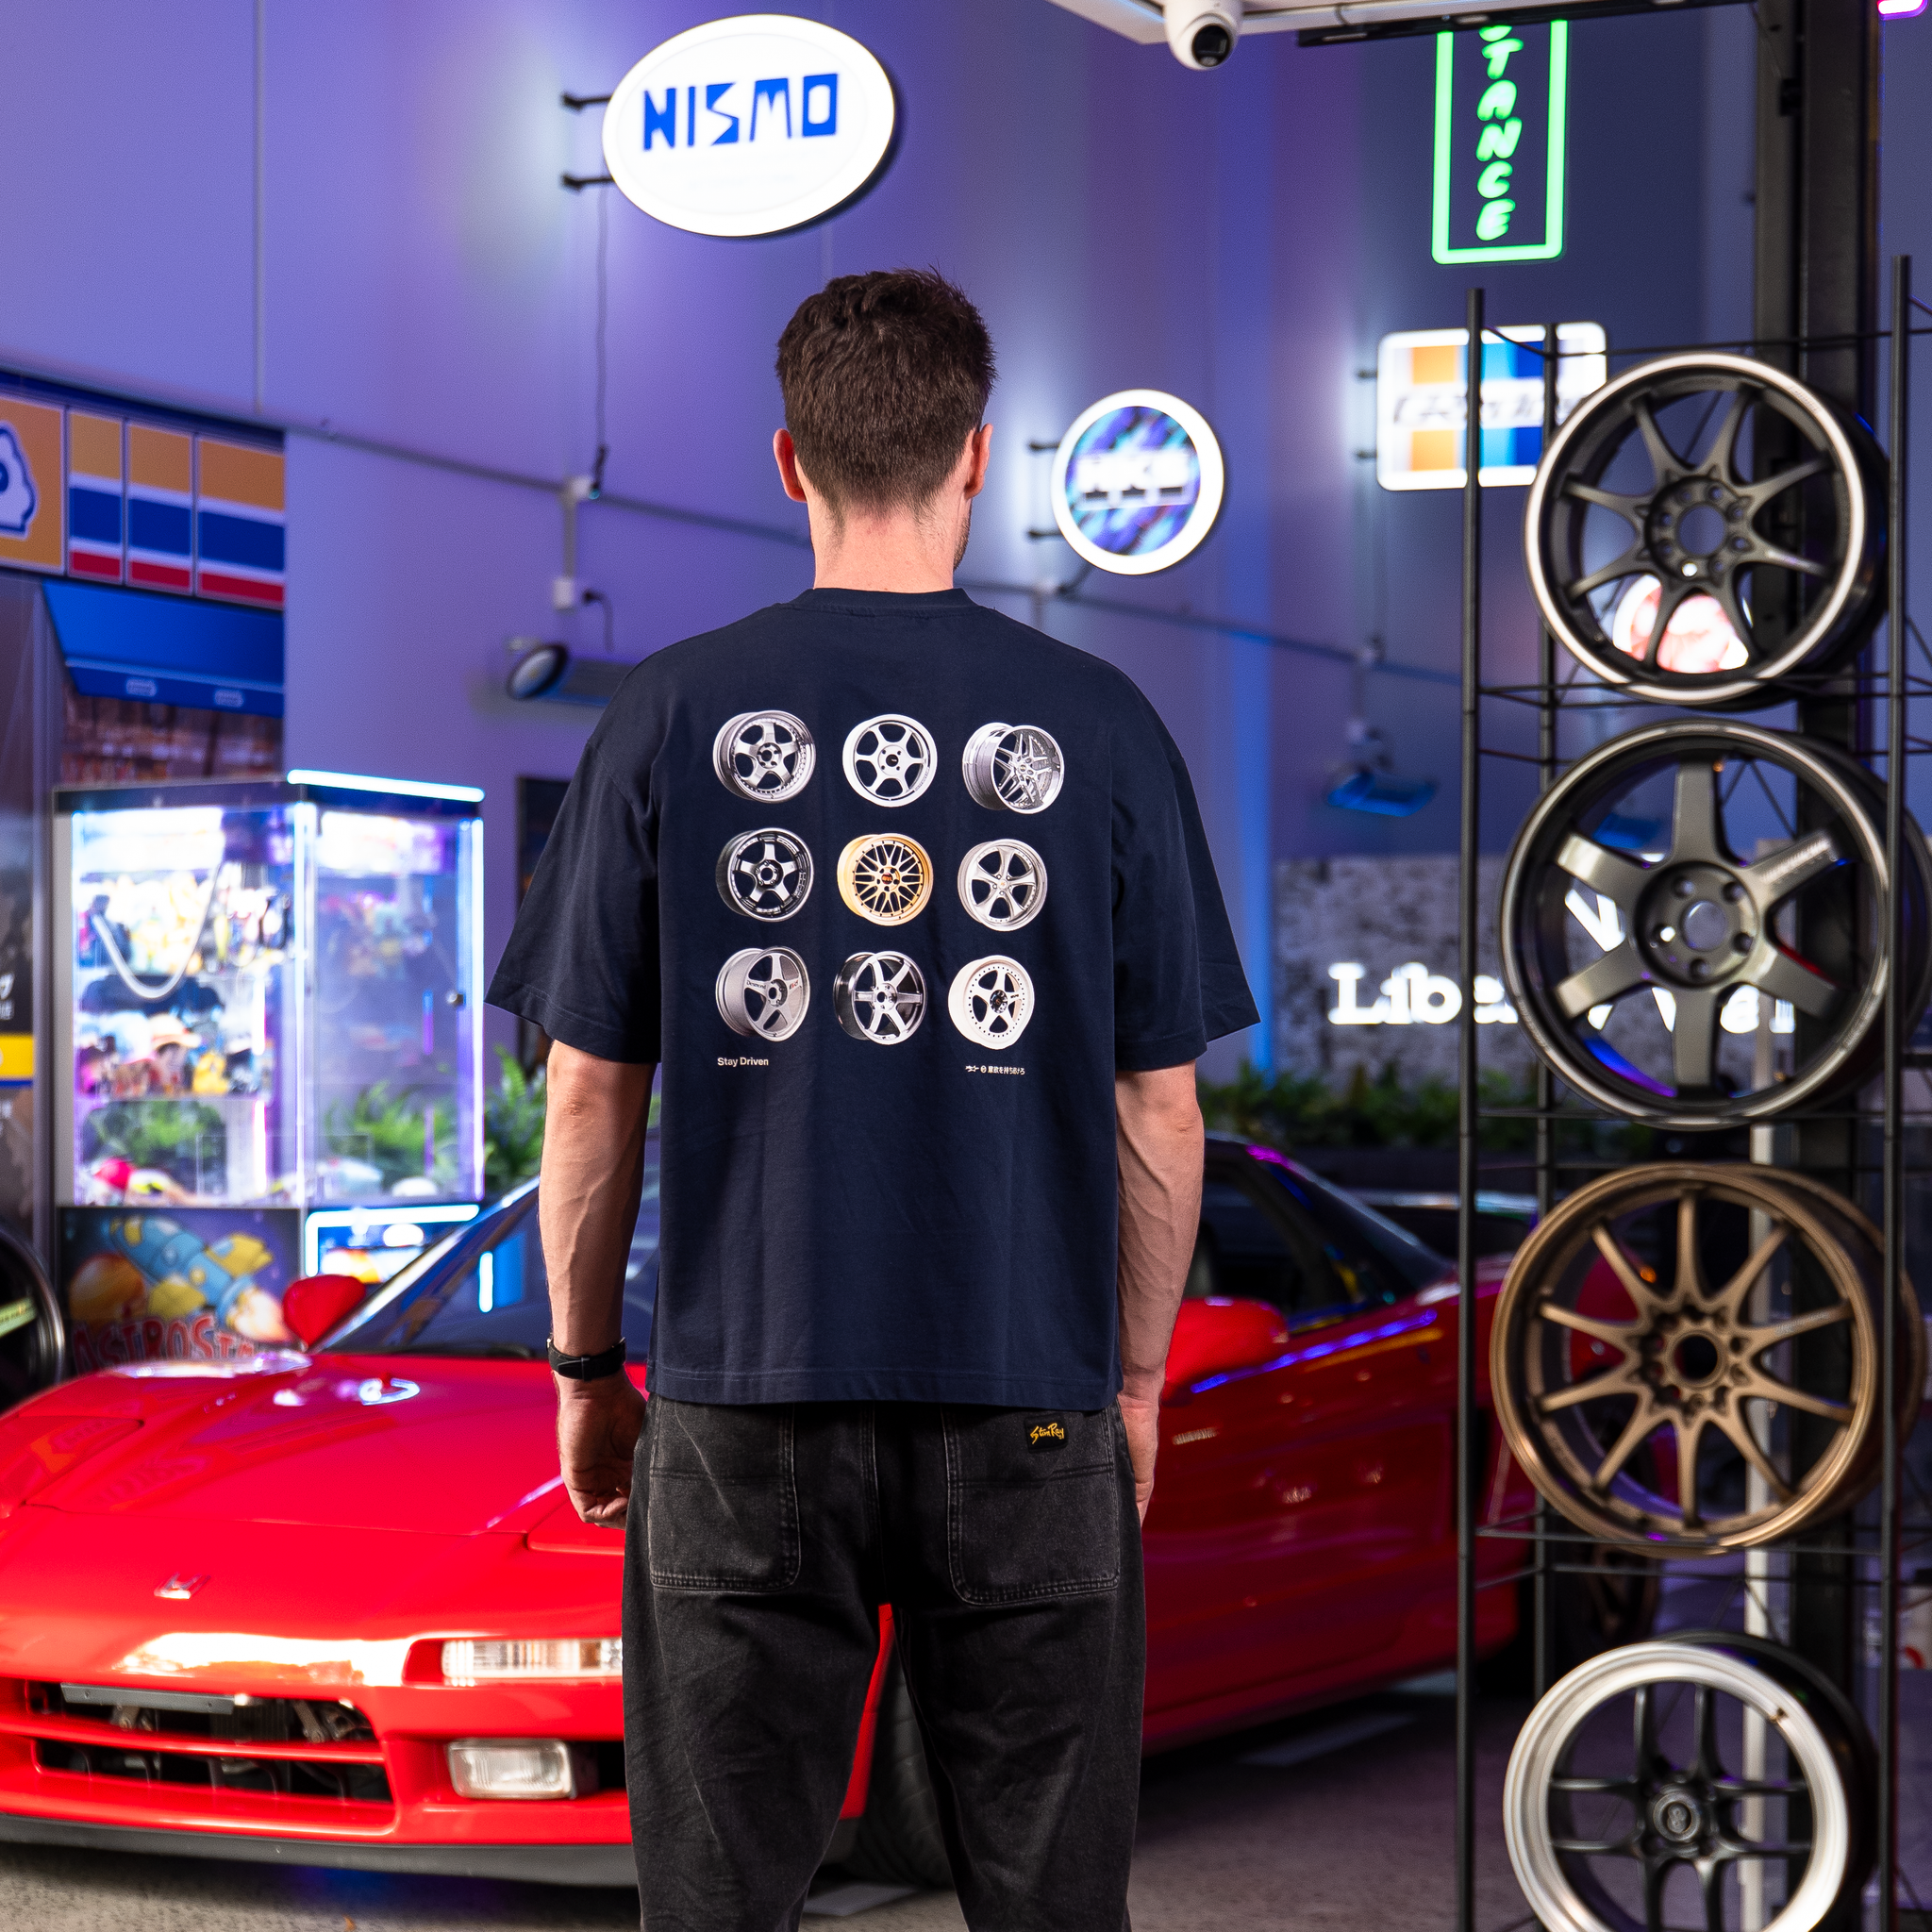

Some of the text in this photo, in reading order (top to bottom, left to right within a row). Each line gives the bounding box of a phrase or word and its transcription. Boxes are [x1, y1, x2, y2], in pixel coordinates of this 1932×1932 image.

[642, 72, 838, 152] NISMO
[717, 1056, 769, 1068] Stay Driven
[1029, 1422, 1065, 1445] Stan Ray
